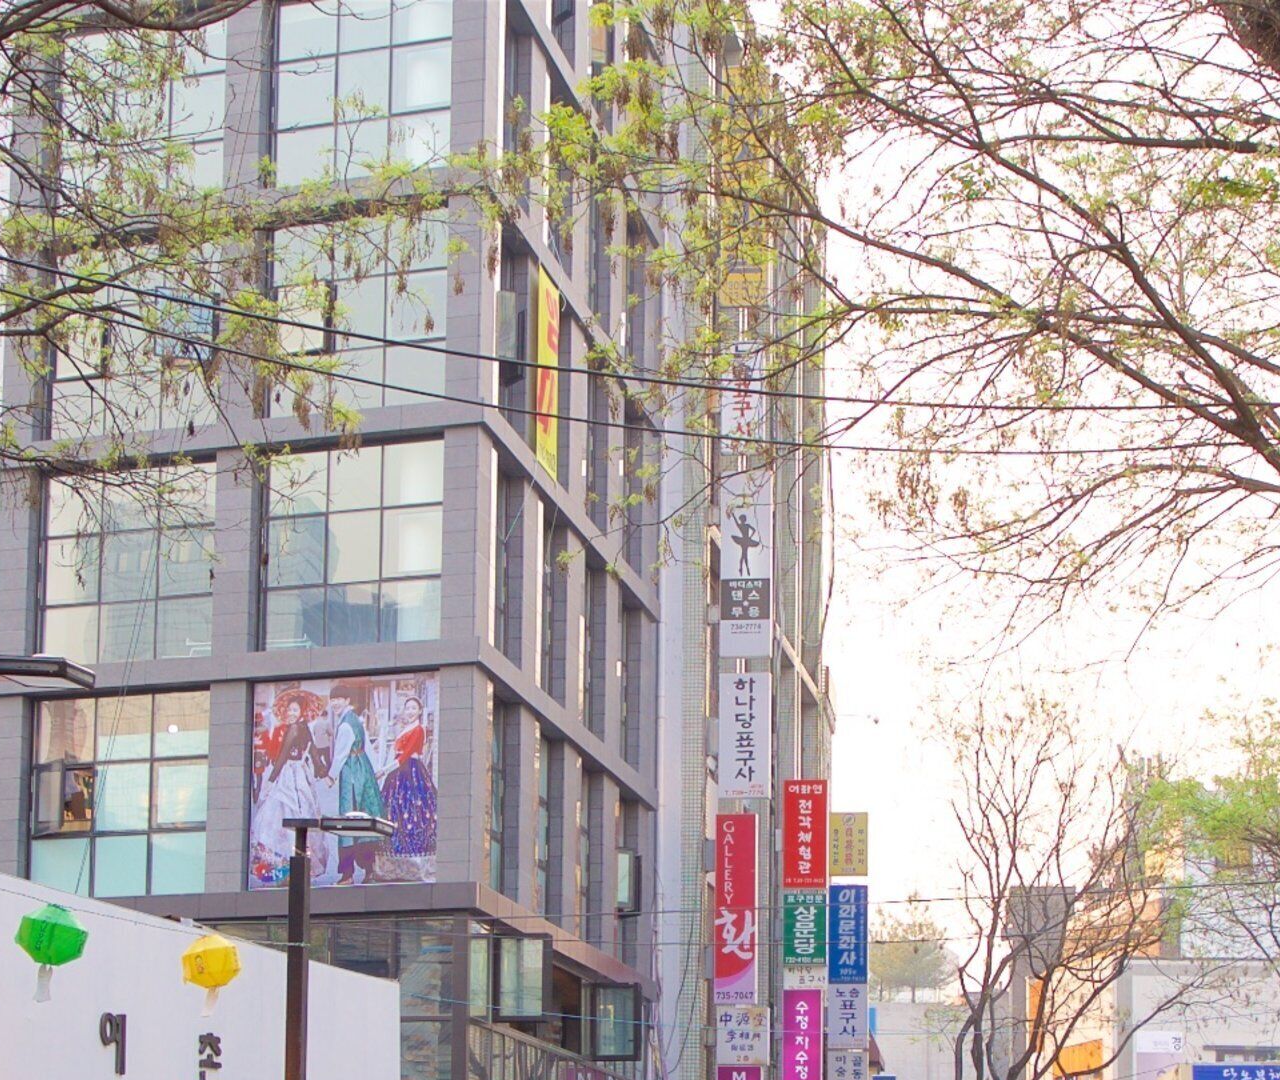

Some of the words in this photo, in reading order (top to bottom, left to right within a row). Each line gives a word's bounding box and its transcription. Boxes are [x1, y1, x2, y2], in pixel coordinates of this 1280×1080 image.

[734, 677, 755, 783] 하나당표구사
[723, 821, 735, 905] GALLERY
[798, 799, 812, 875] 전각체험관
[793, 906, 817, 954] 상문당
[838, 888, 858, 966] 이화문화사
[838, 1000, 858, 1038] 표구사
